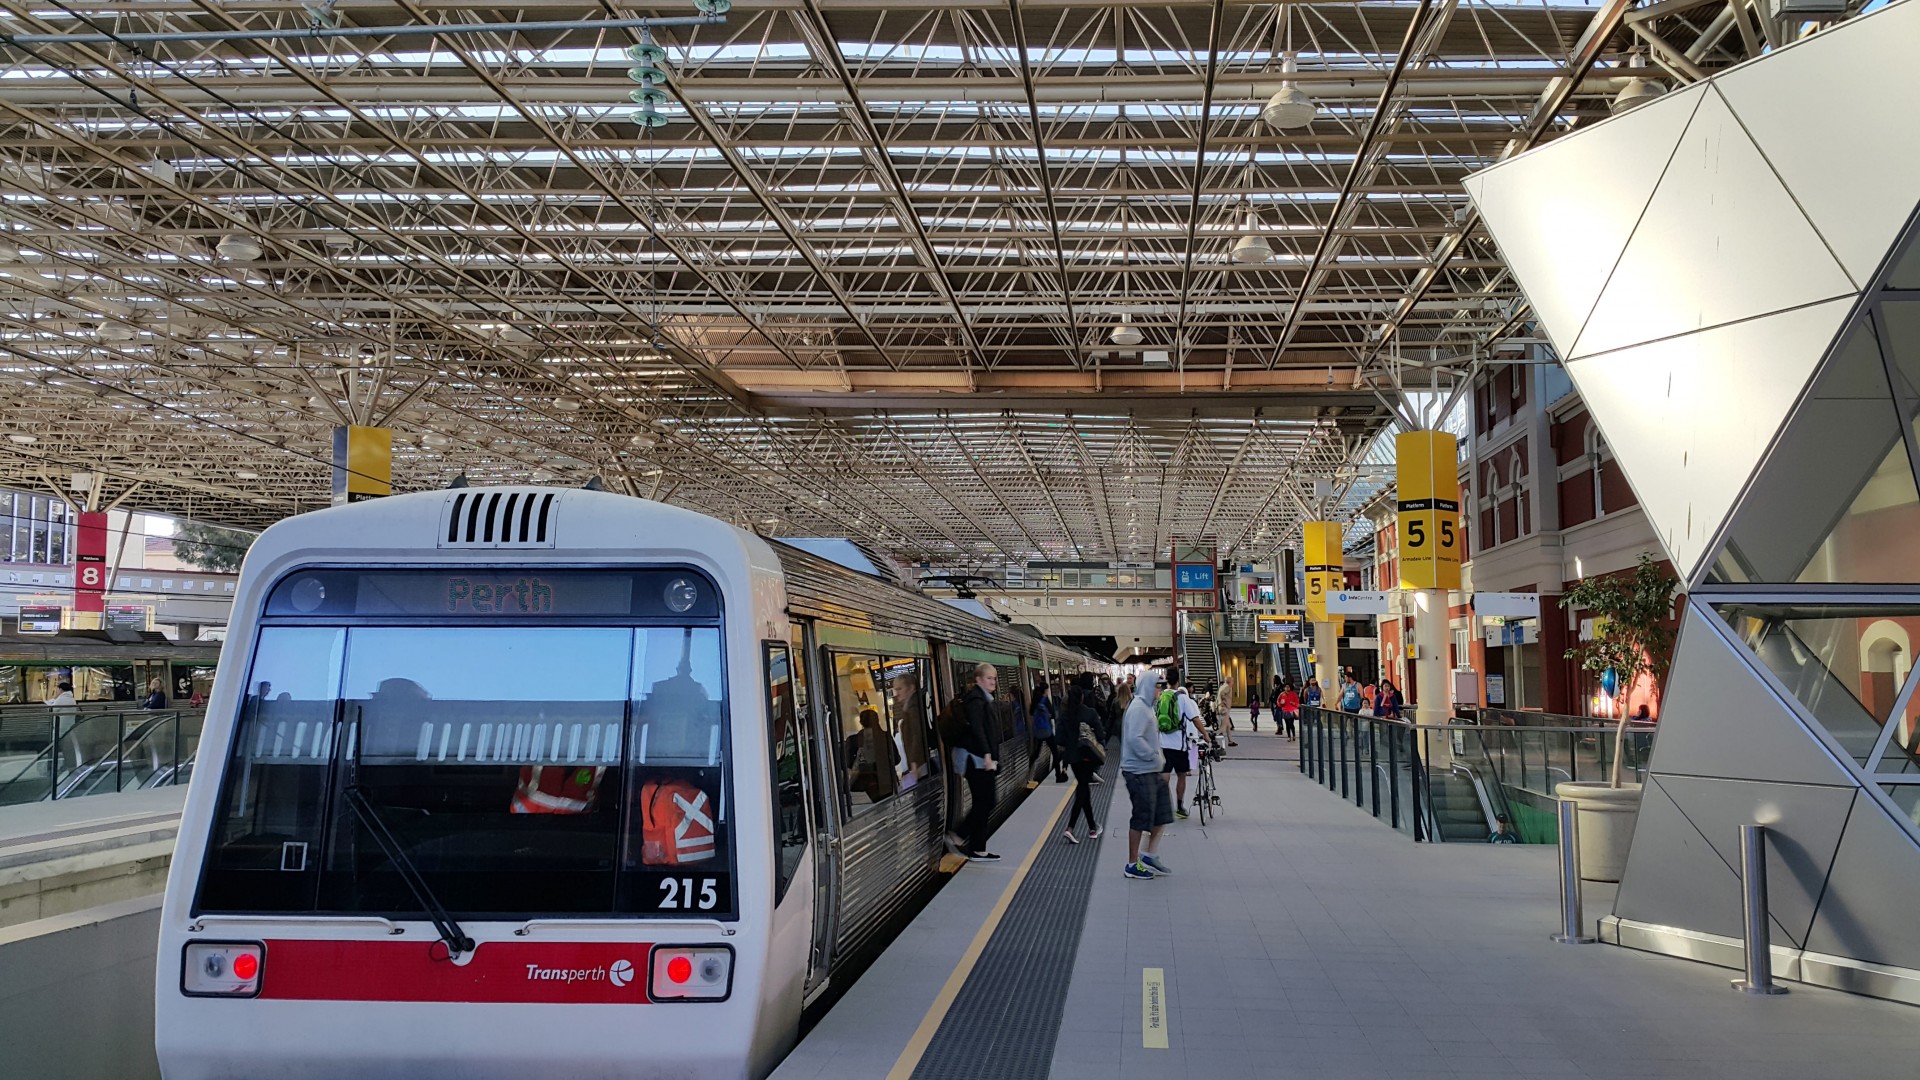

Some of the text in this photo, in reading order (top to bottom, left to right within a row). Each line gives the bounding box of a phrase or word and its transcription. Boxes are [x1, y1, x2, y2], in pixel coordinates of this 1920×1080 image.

[1407, 519, 1425, 547] 5
[1441, 520, 1454, 547] 5
[82, 567, 99, 585] 8
[1194, 572, 1209, 580] Lift
[1311, 577, 1322, 595] 5
[1331, 578, 1340, 591] 5
[447, 578, 552, 613] Perth
[658, 877, 717, 910] 215
[526, 964, 605, 984] Transperth
